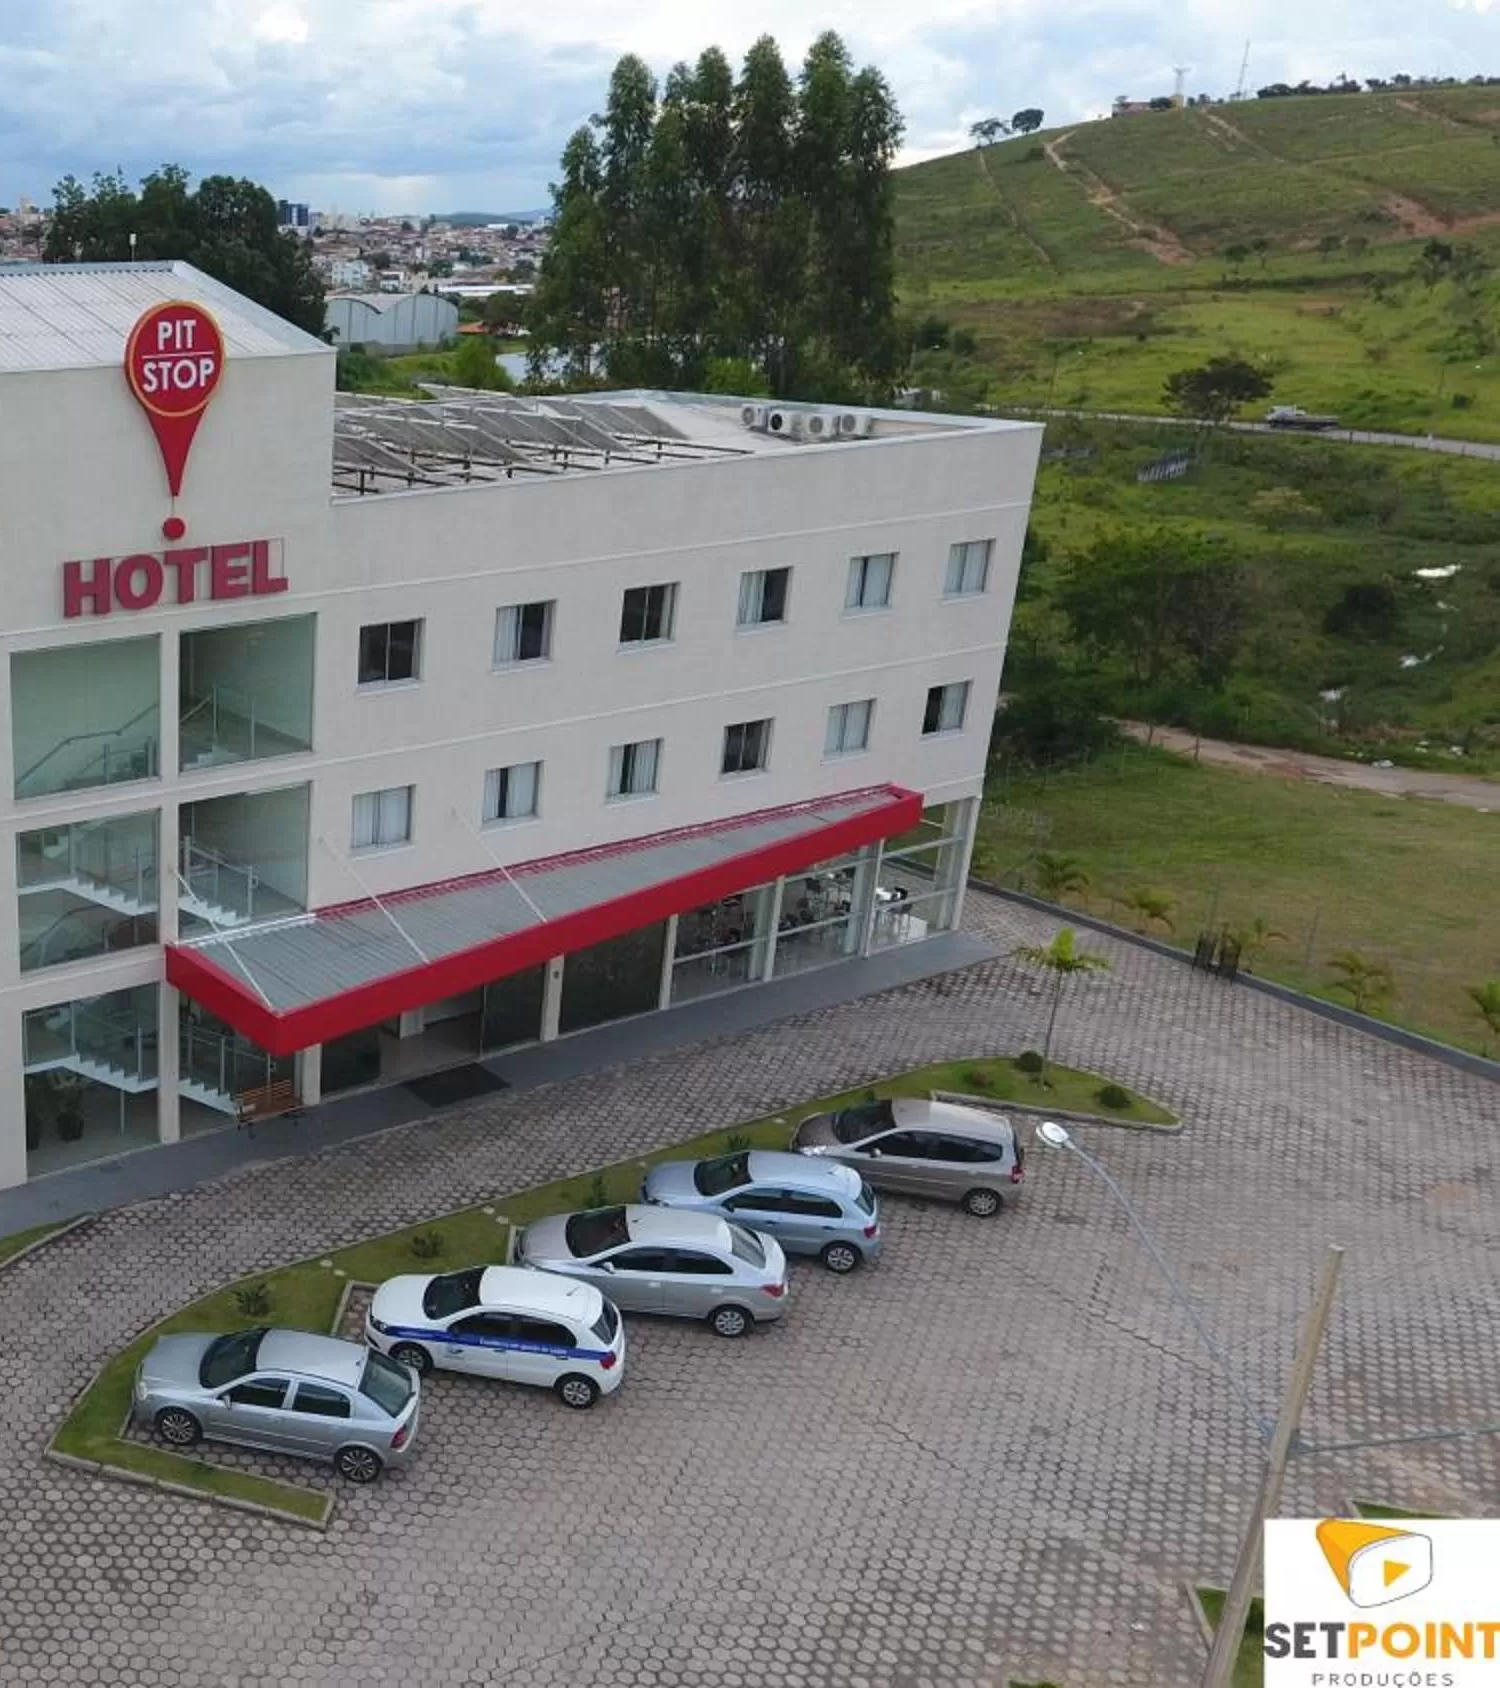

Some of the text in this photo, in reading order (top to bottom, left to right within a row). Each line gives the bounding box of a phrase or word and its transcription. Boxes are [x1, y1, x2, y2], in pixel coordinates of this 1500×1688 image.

[157, 319, 197, 351] PIT
[142, 358, 215, 393] STOP
[62, 538, 289, 619] HOTEL
